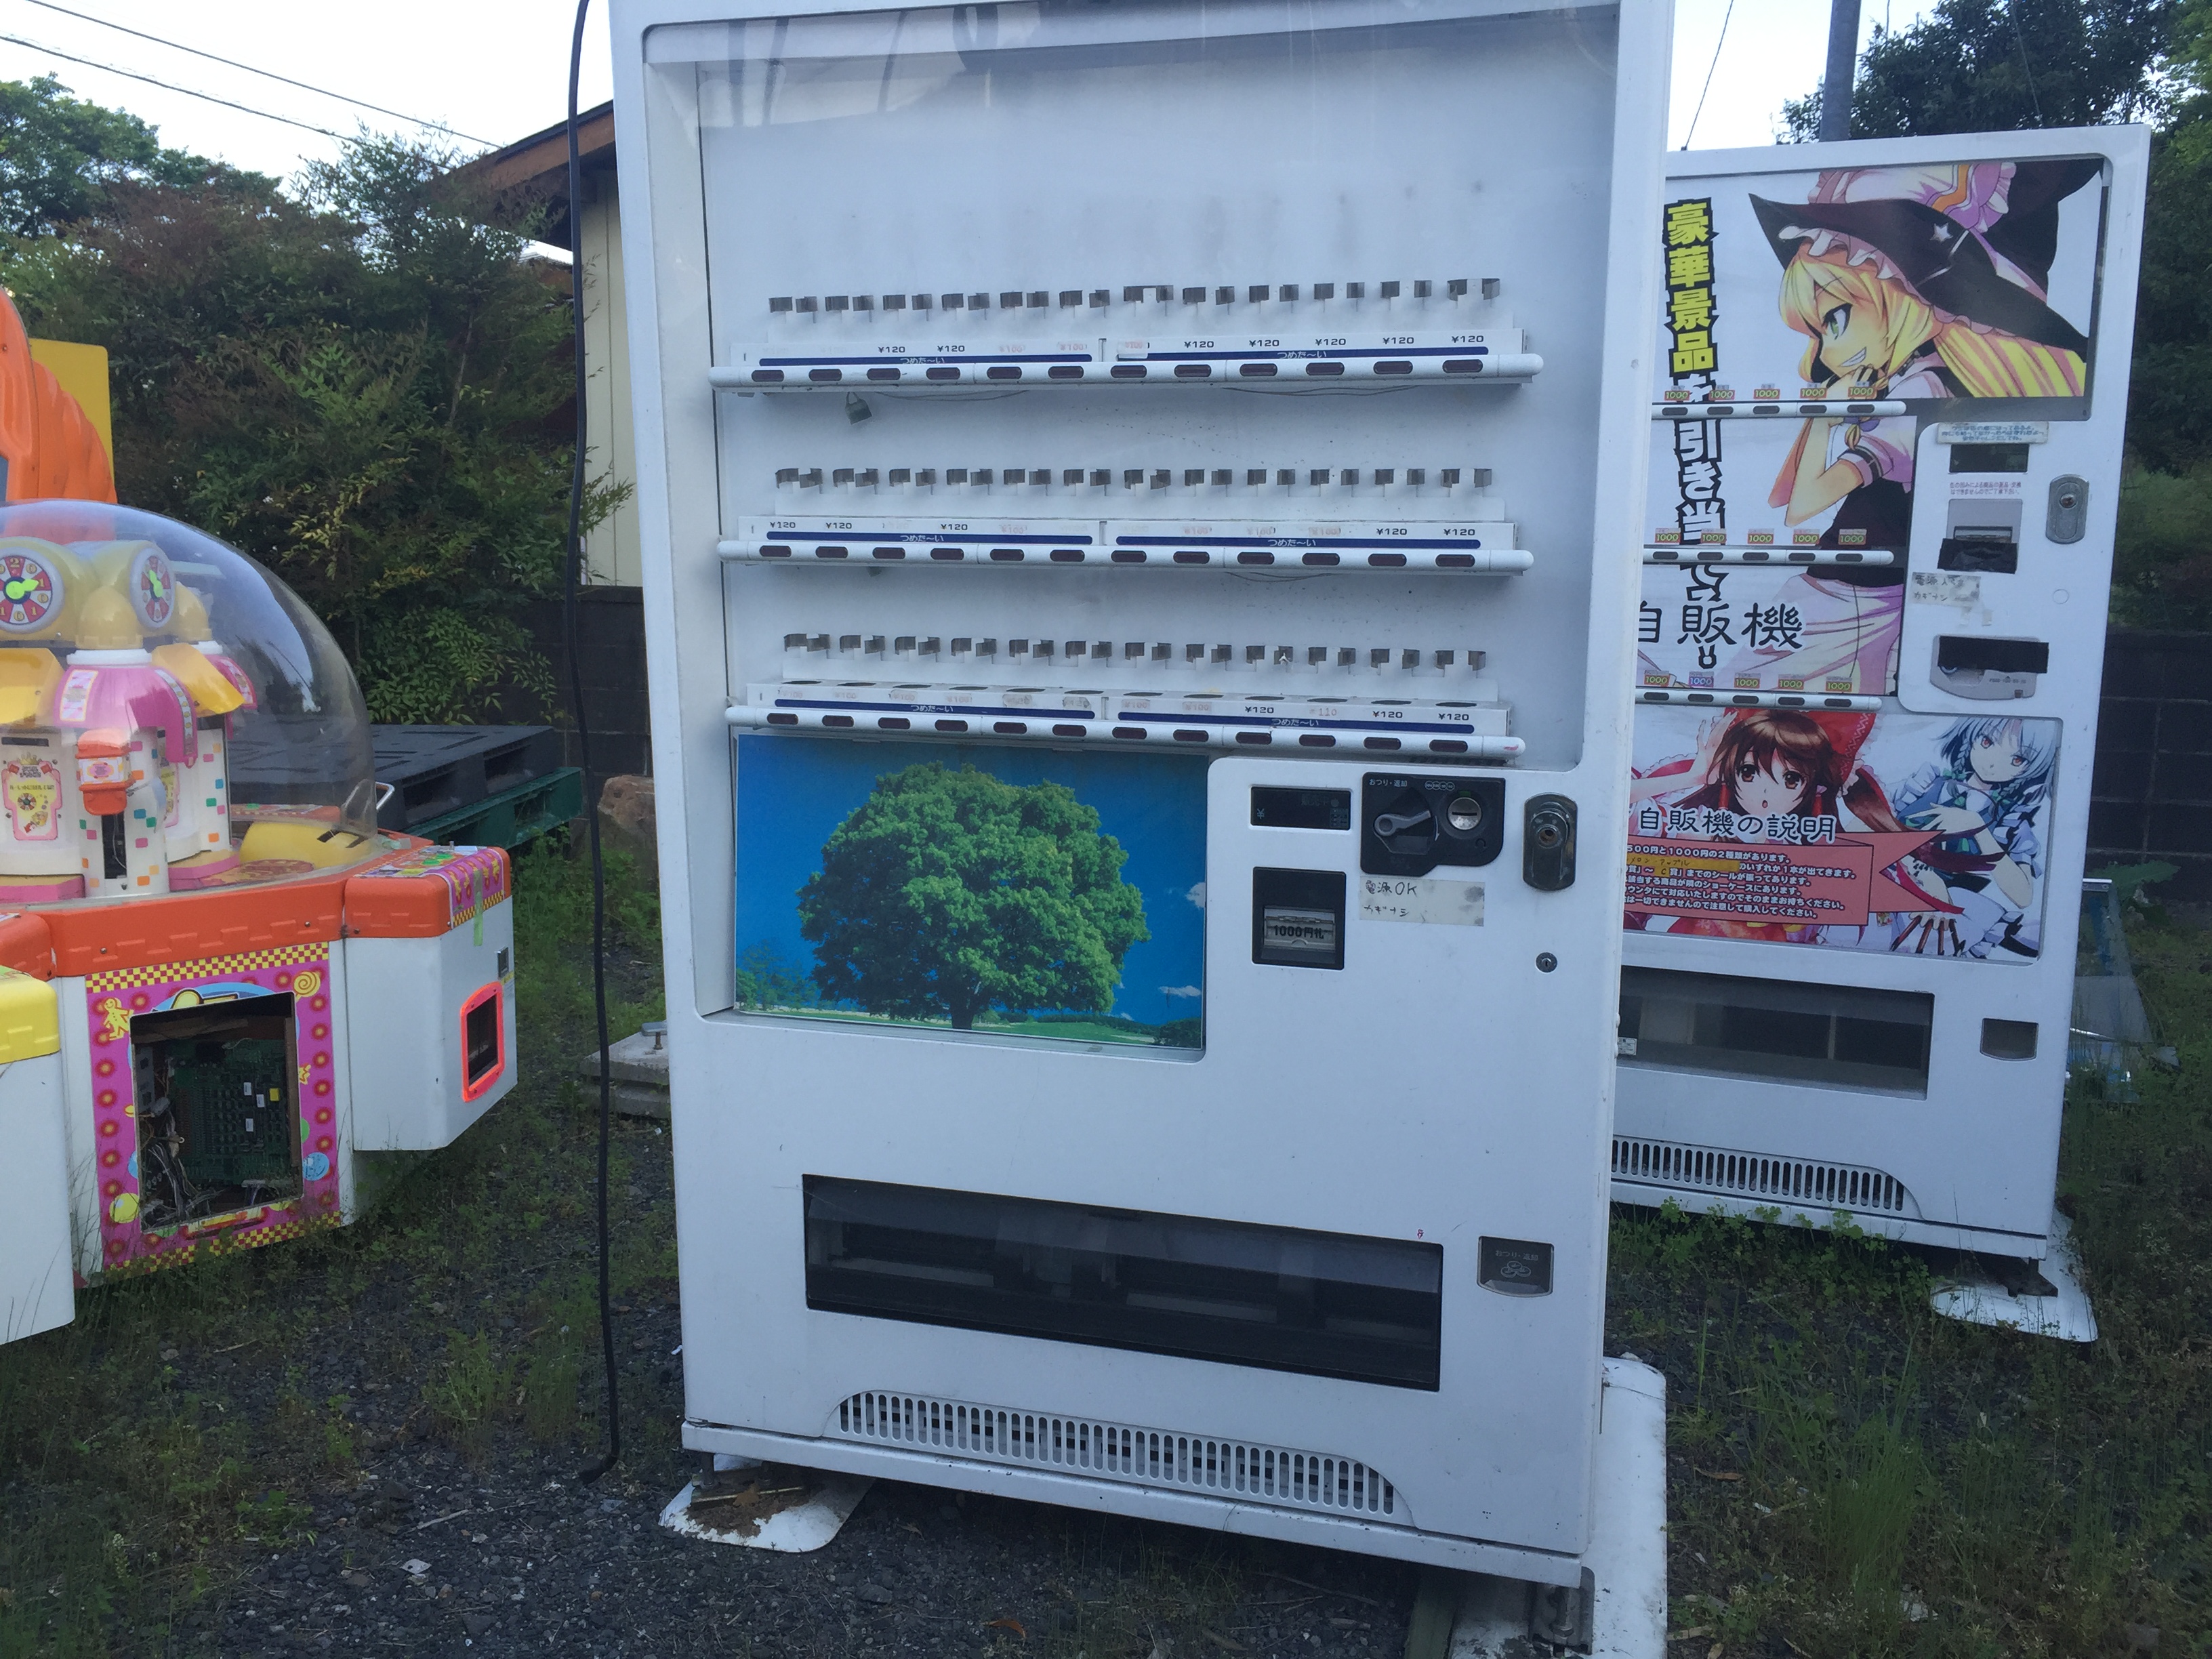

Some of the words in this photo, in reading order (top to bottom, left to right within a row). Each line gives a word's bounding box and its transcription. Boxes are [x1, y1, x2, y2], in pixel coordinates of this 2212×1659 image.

[1666, 391, 1689, 399] 1000
[1711, 390, 1734, 398] 1000
[1849, 388, 1874, 396] 1000
[1656, 533, 1679, 541] 1000
[1748, 534, 1772, 542] 1000
[1840, 535, 1864, 543] 1000
[1638, 602, 1803, 649] 自販機
[1689, 677, 1712, 685] 1000
[1736, 678, 1759, 687] 1000
[1245, 705, 1274, 714] ¥120
[1372, 711, 1403, 719] ¥120
[1640, 808, 1834, 842] 自販機の説明
[1625, 886, 1845, 909] ウンタにて対応いたしますのでそのままお持ちください。
[1274, 925, 1324, 939] 1000円札
